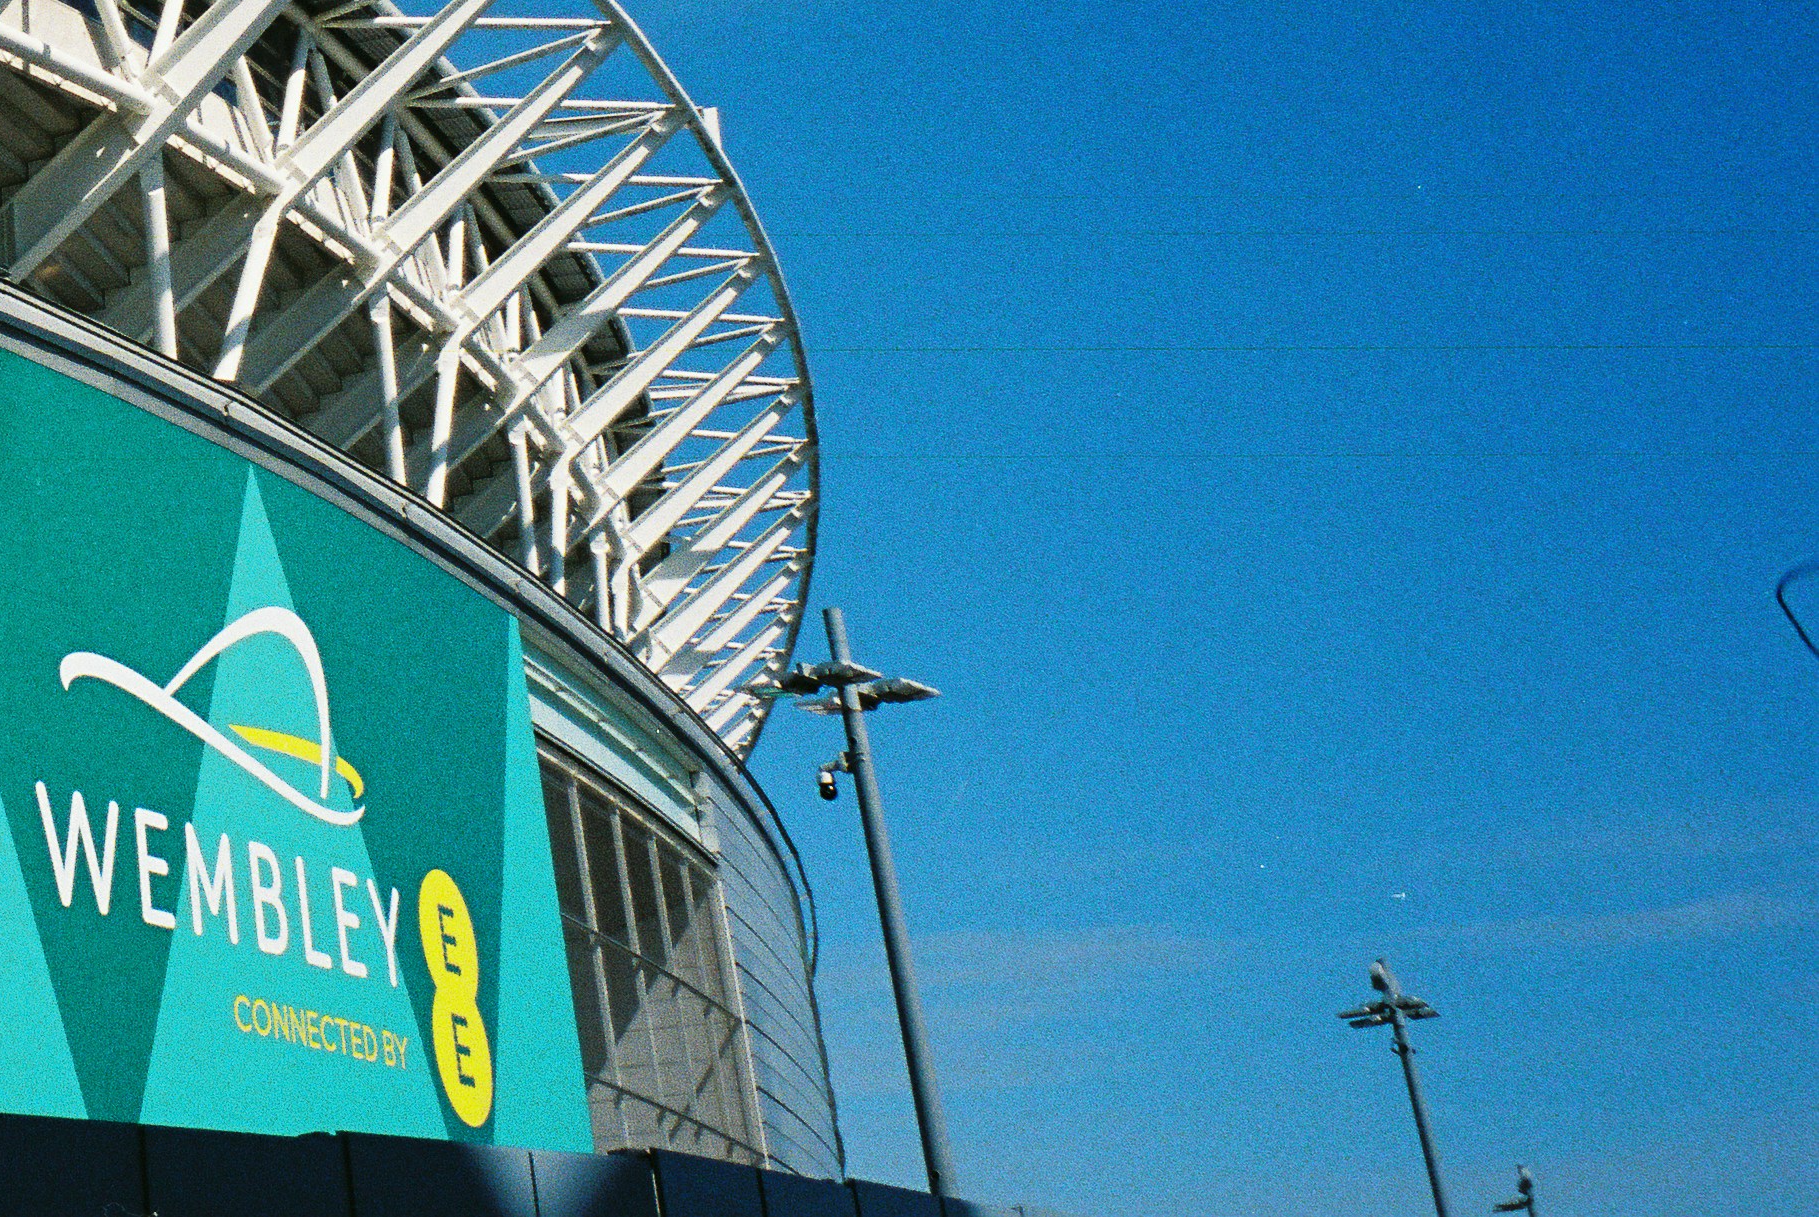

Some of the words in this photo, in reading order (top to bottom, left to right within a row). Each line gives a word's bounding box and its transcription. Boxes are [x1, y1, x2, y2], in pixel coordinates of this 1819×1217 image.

[35, 780, 400, 988] WEMBLEY
[233, 994, 378, 1063] CONNECTED
[383, 1029, 409, 1070] BY
[438, 902, 476, 1088] EE
